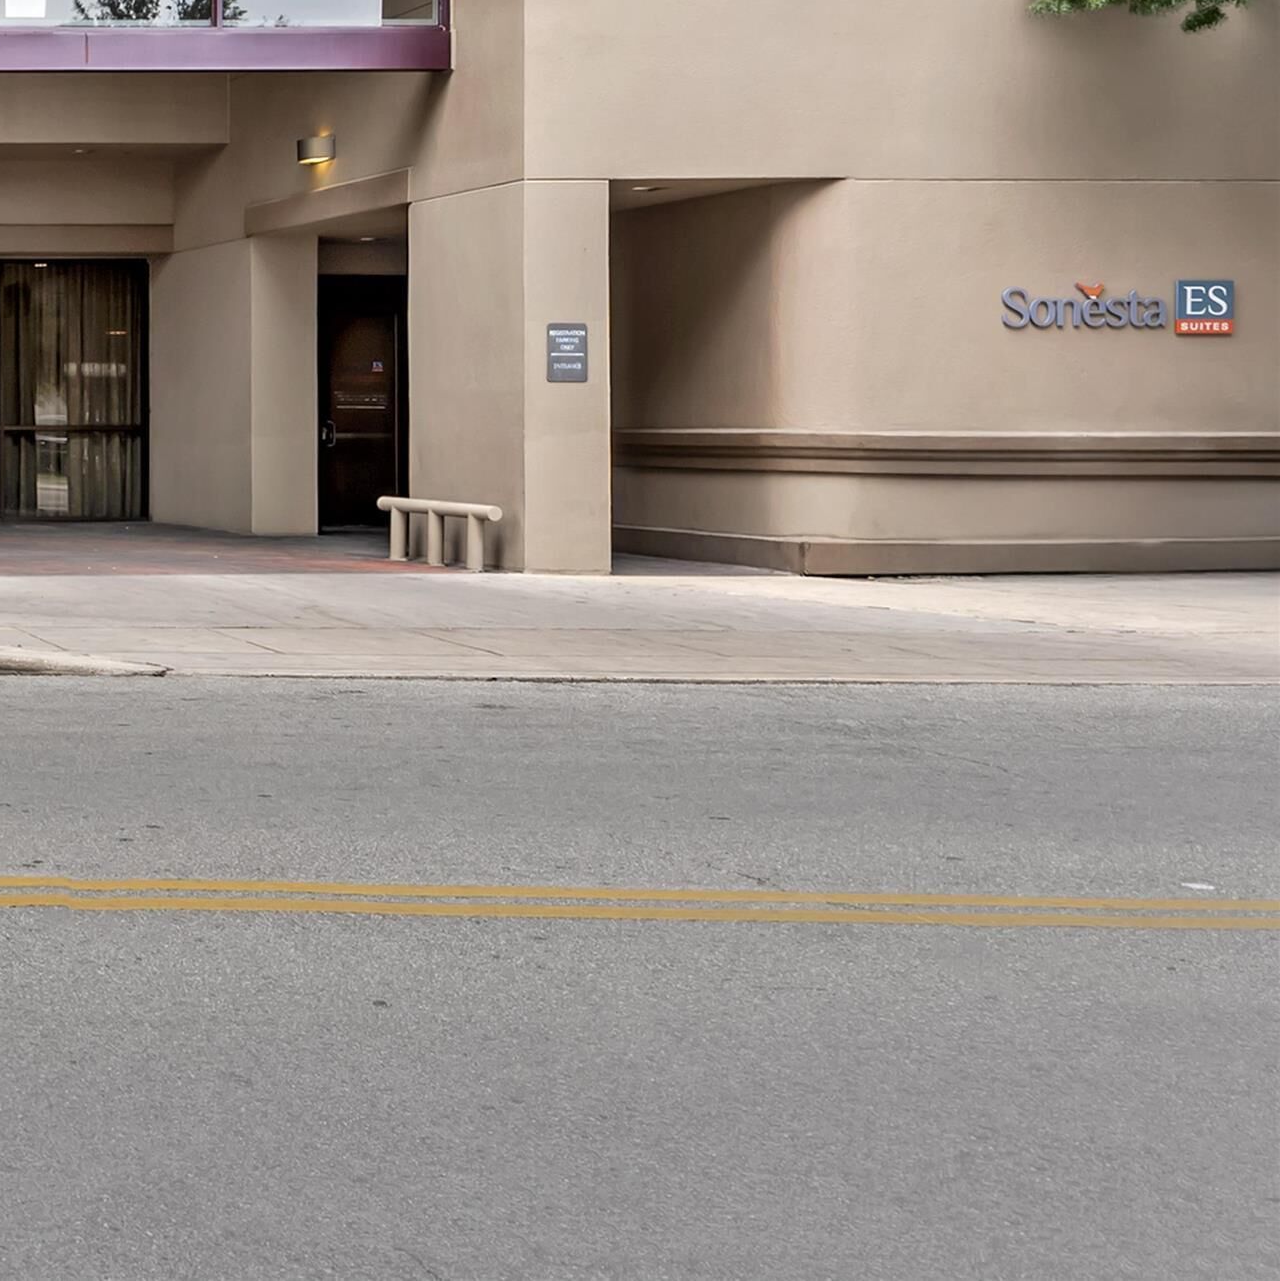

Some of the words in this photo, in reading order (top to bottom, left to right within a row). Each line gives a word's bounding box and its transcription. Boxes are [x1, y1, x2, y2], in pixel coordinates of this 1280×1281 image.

[1001, 286, 1168, 330] Sonesta
[1183, 285, 1229, 316] ES
[1180, 320, 1230, 332] SUITES
